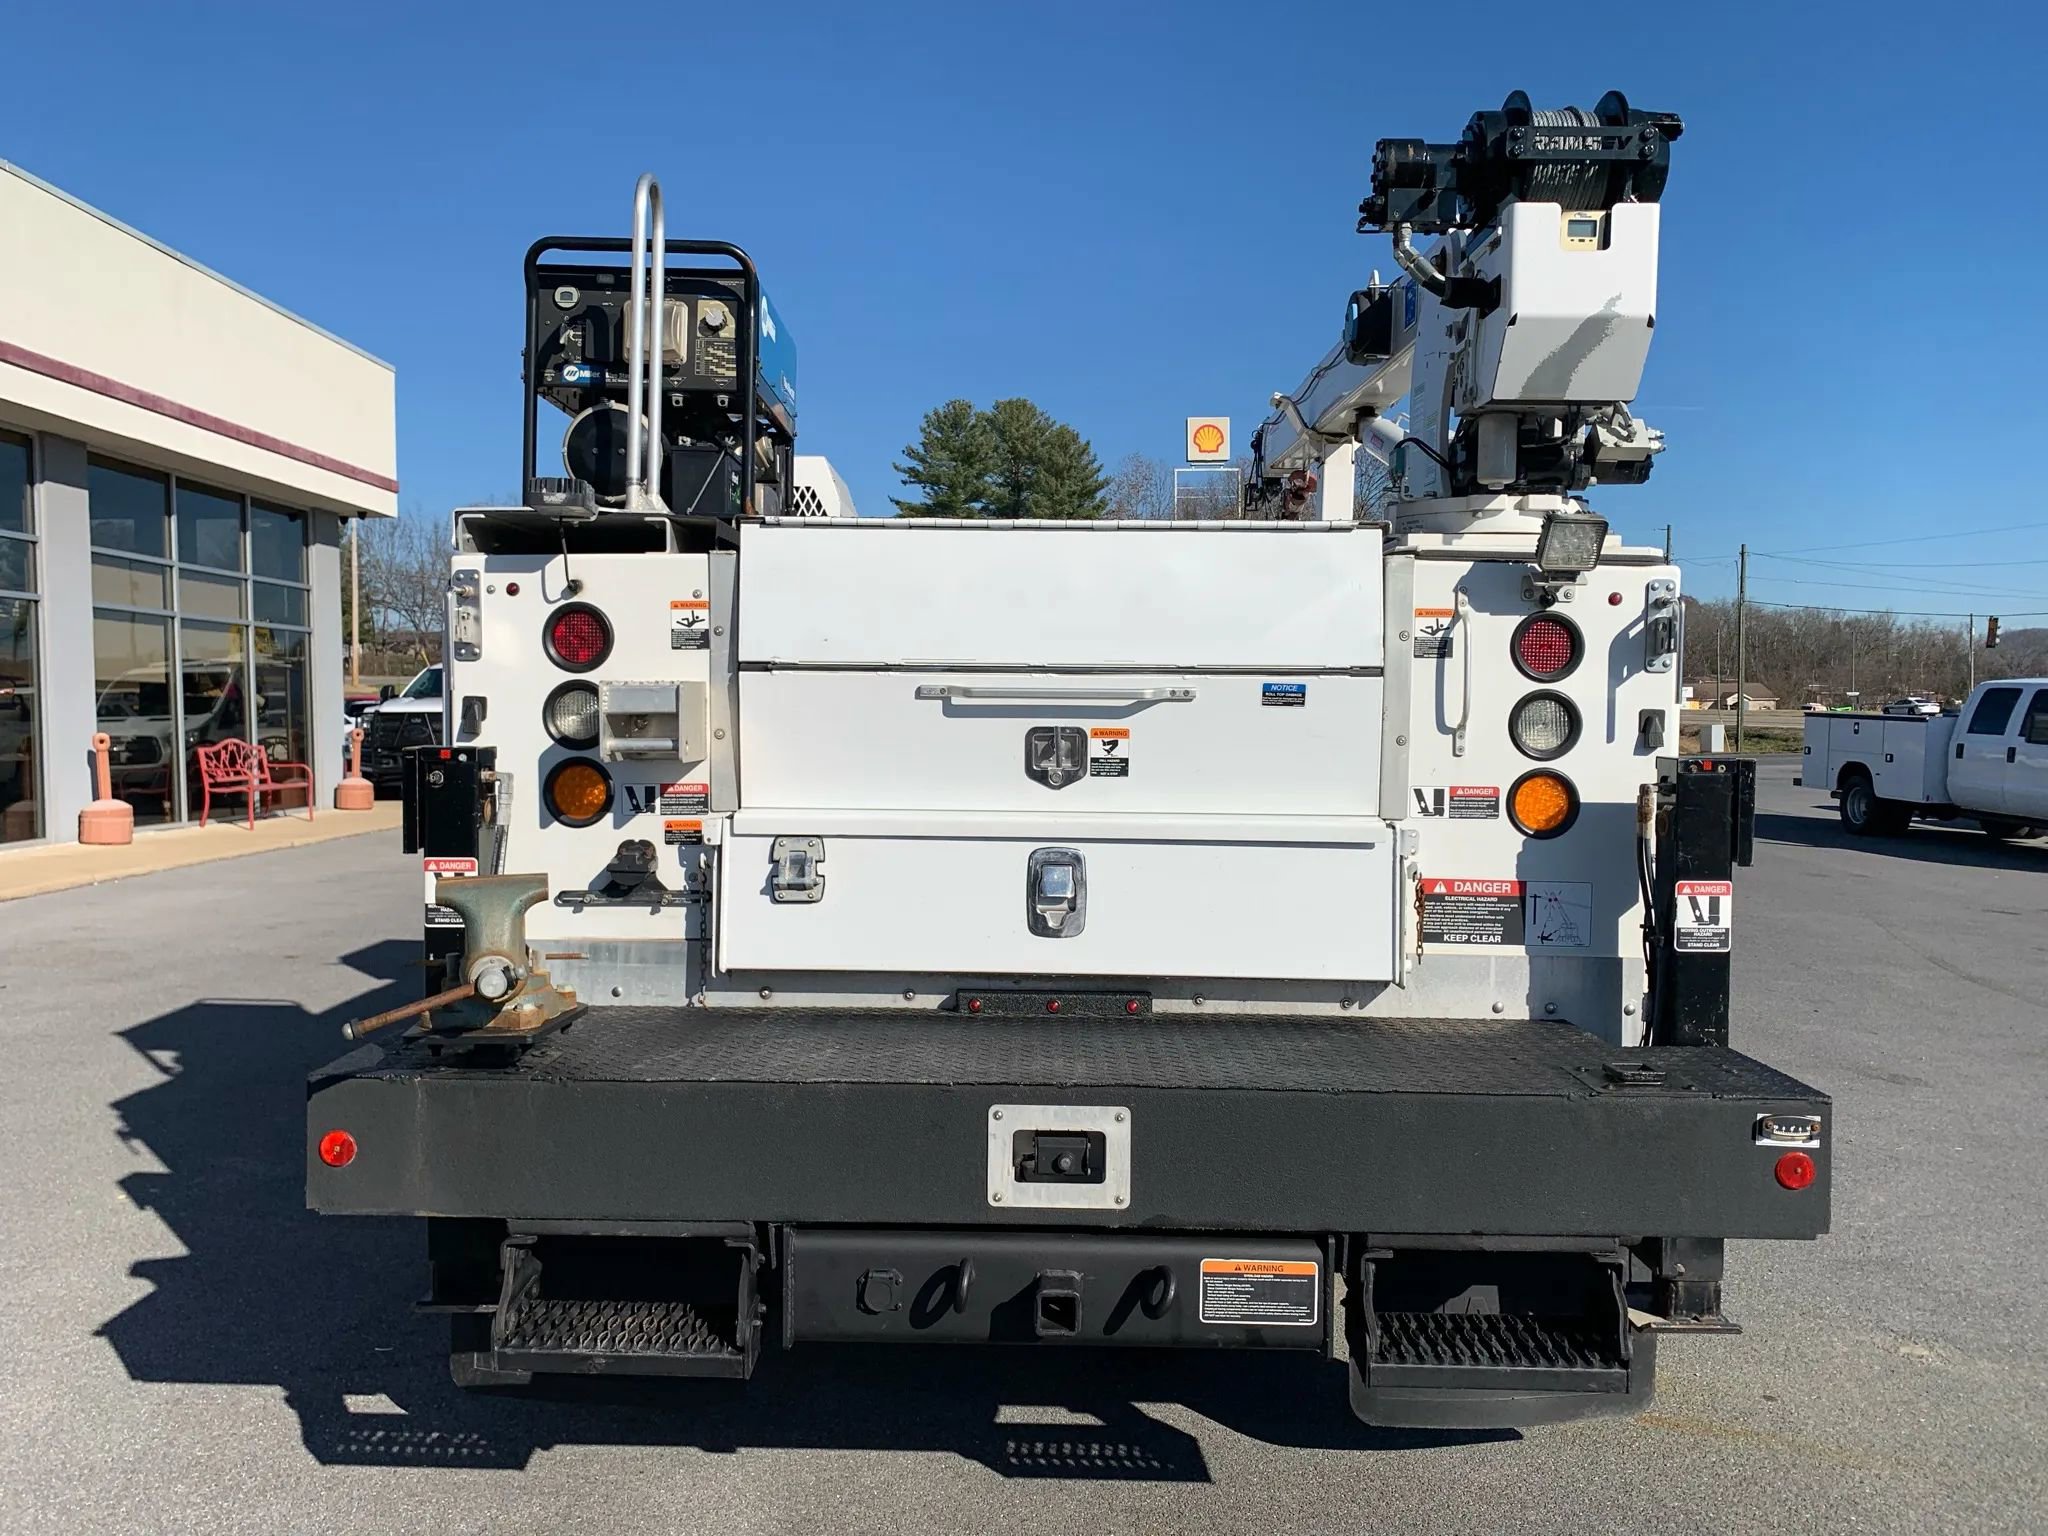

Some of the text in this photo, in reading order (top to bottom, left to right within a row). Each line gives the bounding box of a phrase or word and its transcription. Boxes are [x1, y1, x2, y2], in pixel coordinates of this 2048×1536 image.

[1533, 135, 1633, 150] RAMSEY
[1454, 881, 1512, 894] DANGER
[1694, 885, 1727, 894] DANGER
